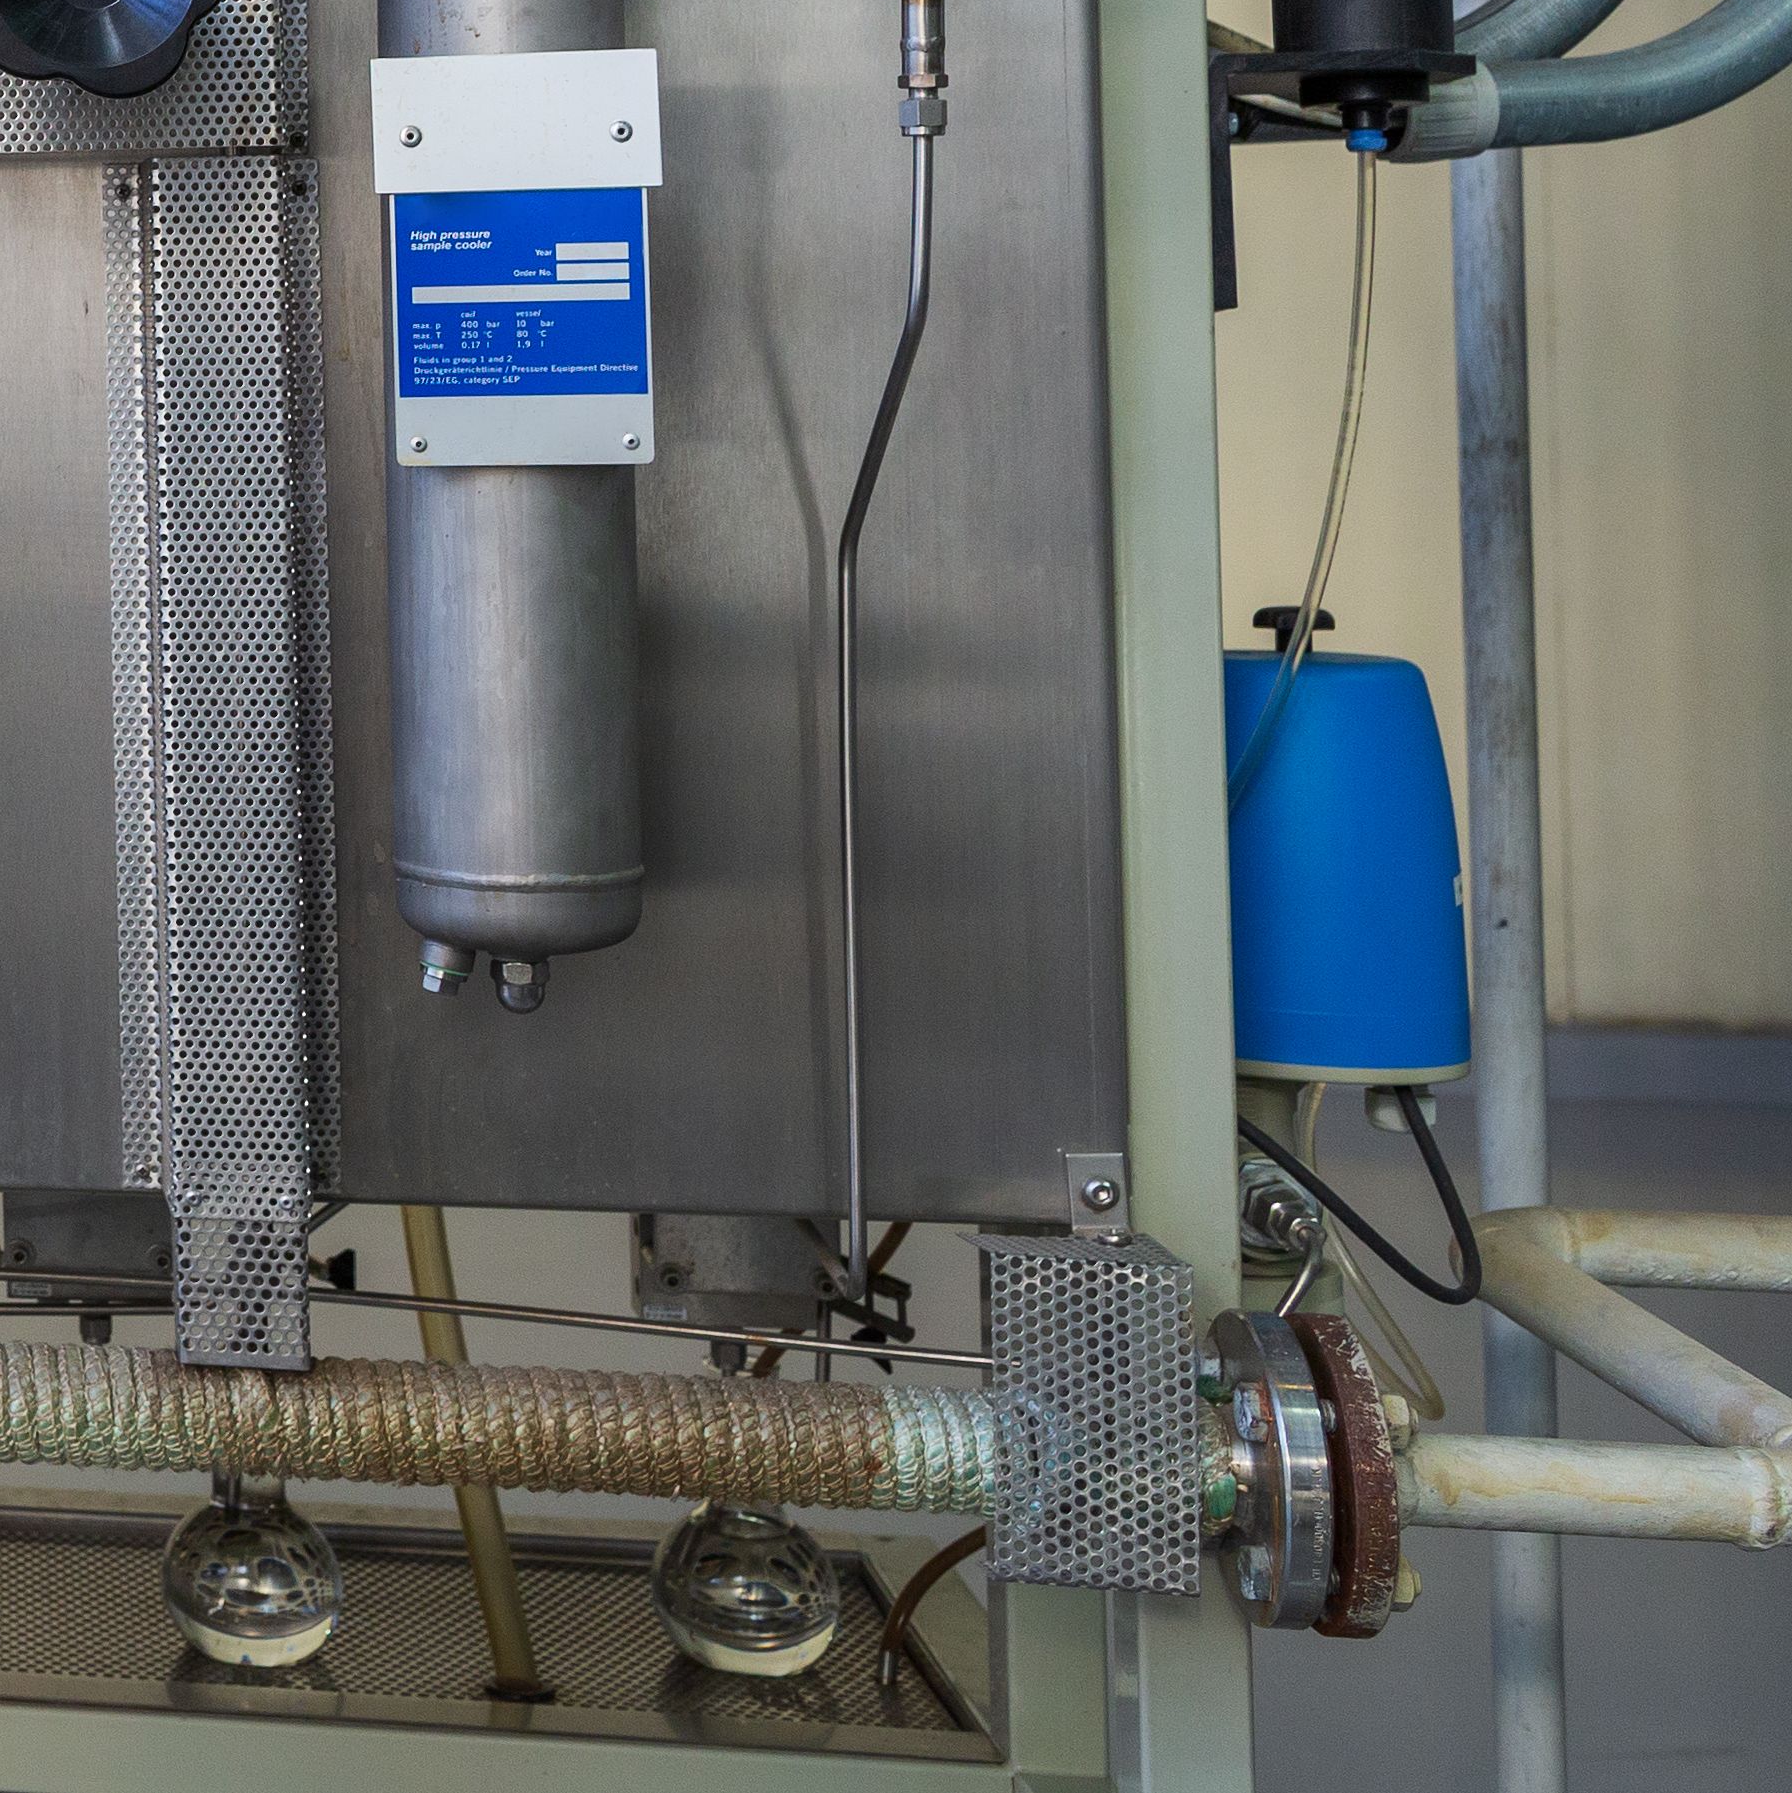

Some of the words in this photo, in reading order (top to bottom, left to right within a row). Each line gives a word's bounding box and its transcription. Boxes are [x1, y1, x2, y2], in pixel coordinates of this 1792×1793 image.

[410, 231, 437, 241] High
[440, 230, 490, 241] pressure
[410, 242, 452, 252] sample
[455, 240, 492, 250] cooler
[535, 249, 552, 257] Year
[539, 269, 552, 277] No.
[486, 320, 500, 328] bar
[541, 319, 554, 327] bar
[516, 330, 528, 338] 80
[461, 341, 480, 349] 0.17
[453, 357, 477, 365] group
[511, 365, 548, 373] Pressure
[551, 364, 597, 373] Equipment
[600, 363, 638, 371] Directive
[464, 376, 499, 385] category
[503, 375, 520, 383] SEP
